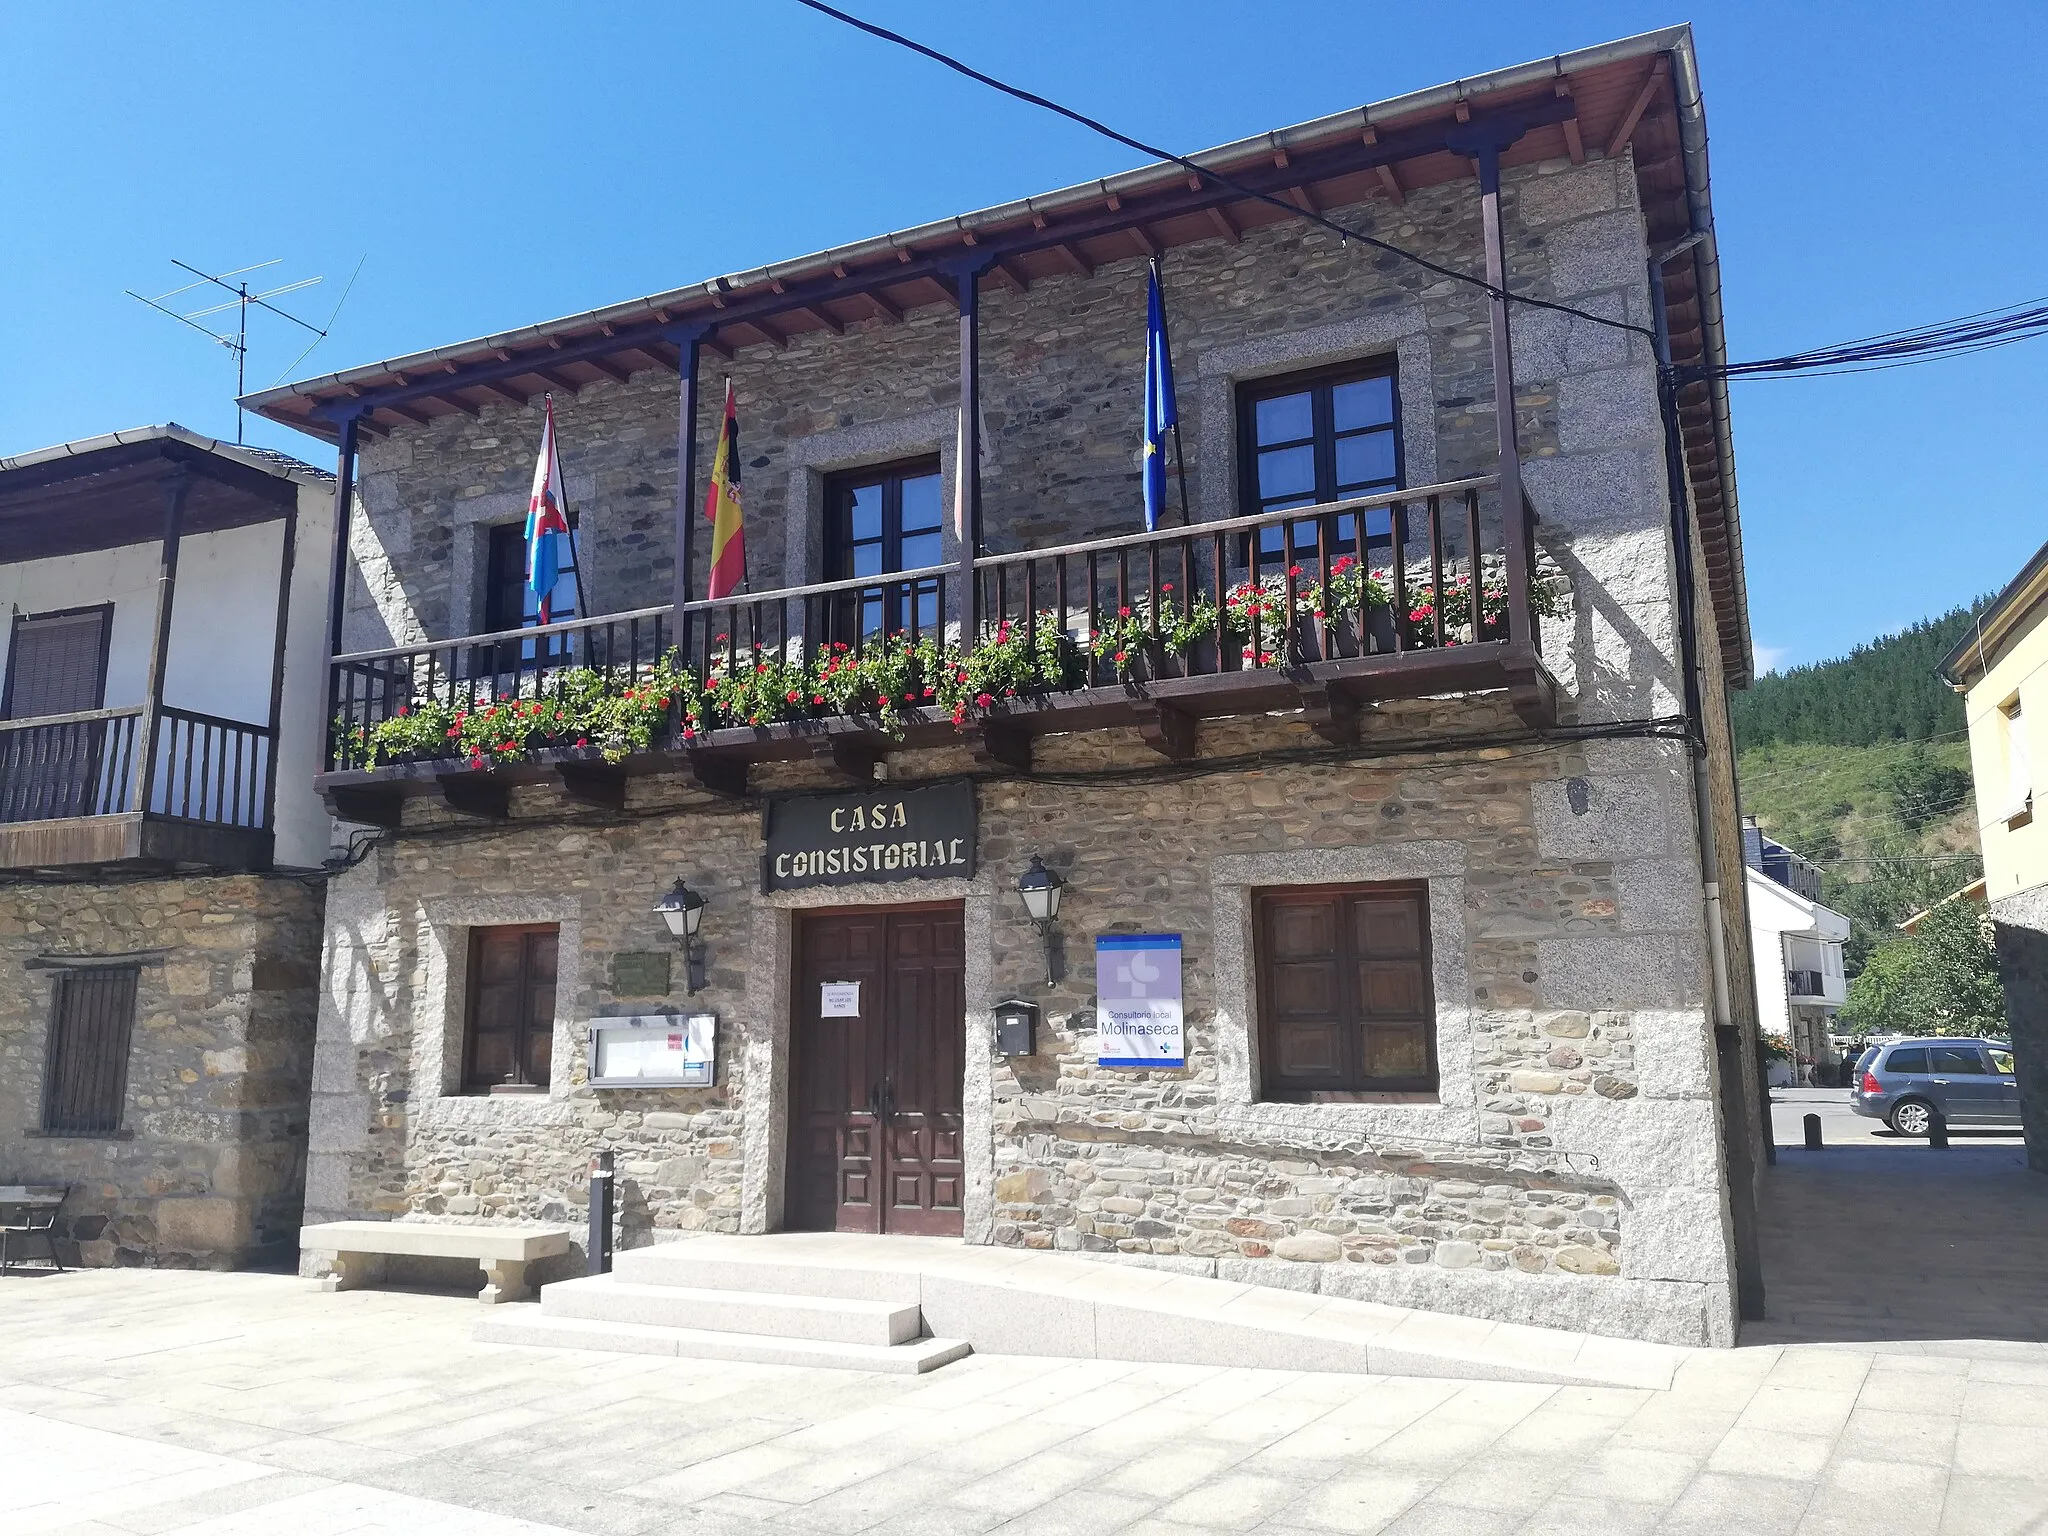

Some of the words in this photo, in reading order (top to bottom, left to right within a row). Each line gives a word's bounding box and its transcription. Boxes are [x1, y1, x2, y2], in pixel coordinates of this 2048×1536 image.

[830, 801, 907, 833] CASA
[775, 838, 966, 878] CONSISTORIAL
[1108, 1010, 1152, 1019] Consultorio
[1153, 1010, 1172, 1019] local
[1101, 1022, 1179, 1034] Molinaseca
